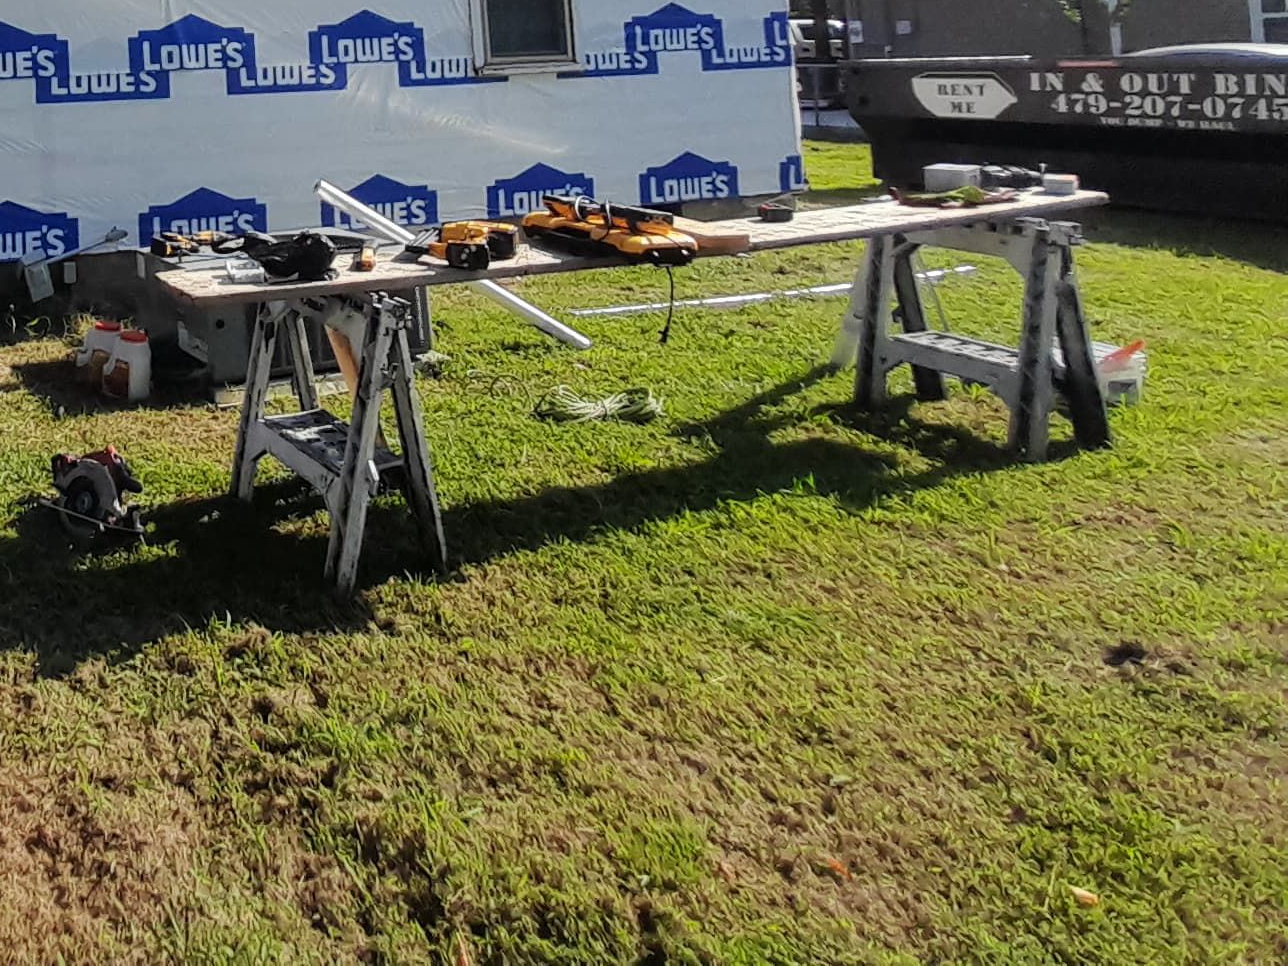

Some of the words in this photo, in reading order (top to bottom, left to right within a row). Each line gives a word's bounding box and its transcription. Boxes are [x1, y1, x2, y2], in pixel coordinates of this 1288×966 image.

[320, 32, 414, 64] LOWE'S
[634, 22, 715, 52] LOWE'S
[142, 37, 244, 71] LOWE'S
[937, 83, 987, 97] RENT
[1029, 72, 1064, 91] IN
[1081, 72, 1104, 92] &
[1119, 72, 1196, 95] OUT
[949, 101, 977, 114] ME
[1052, 93, 1288, 120] 479-207-0745
[650, 171, 730, 203] LOWE'S
